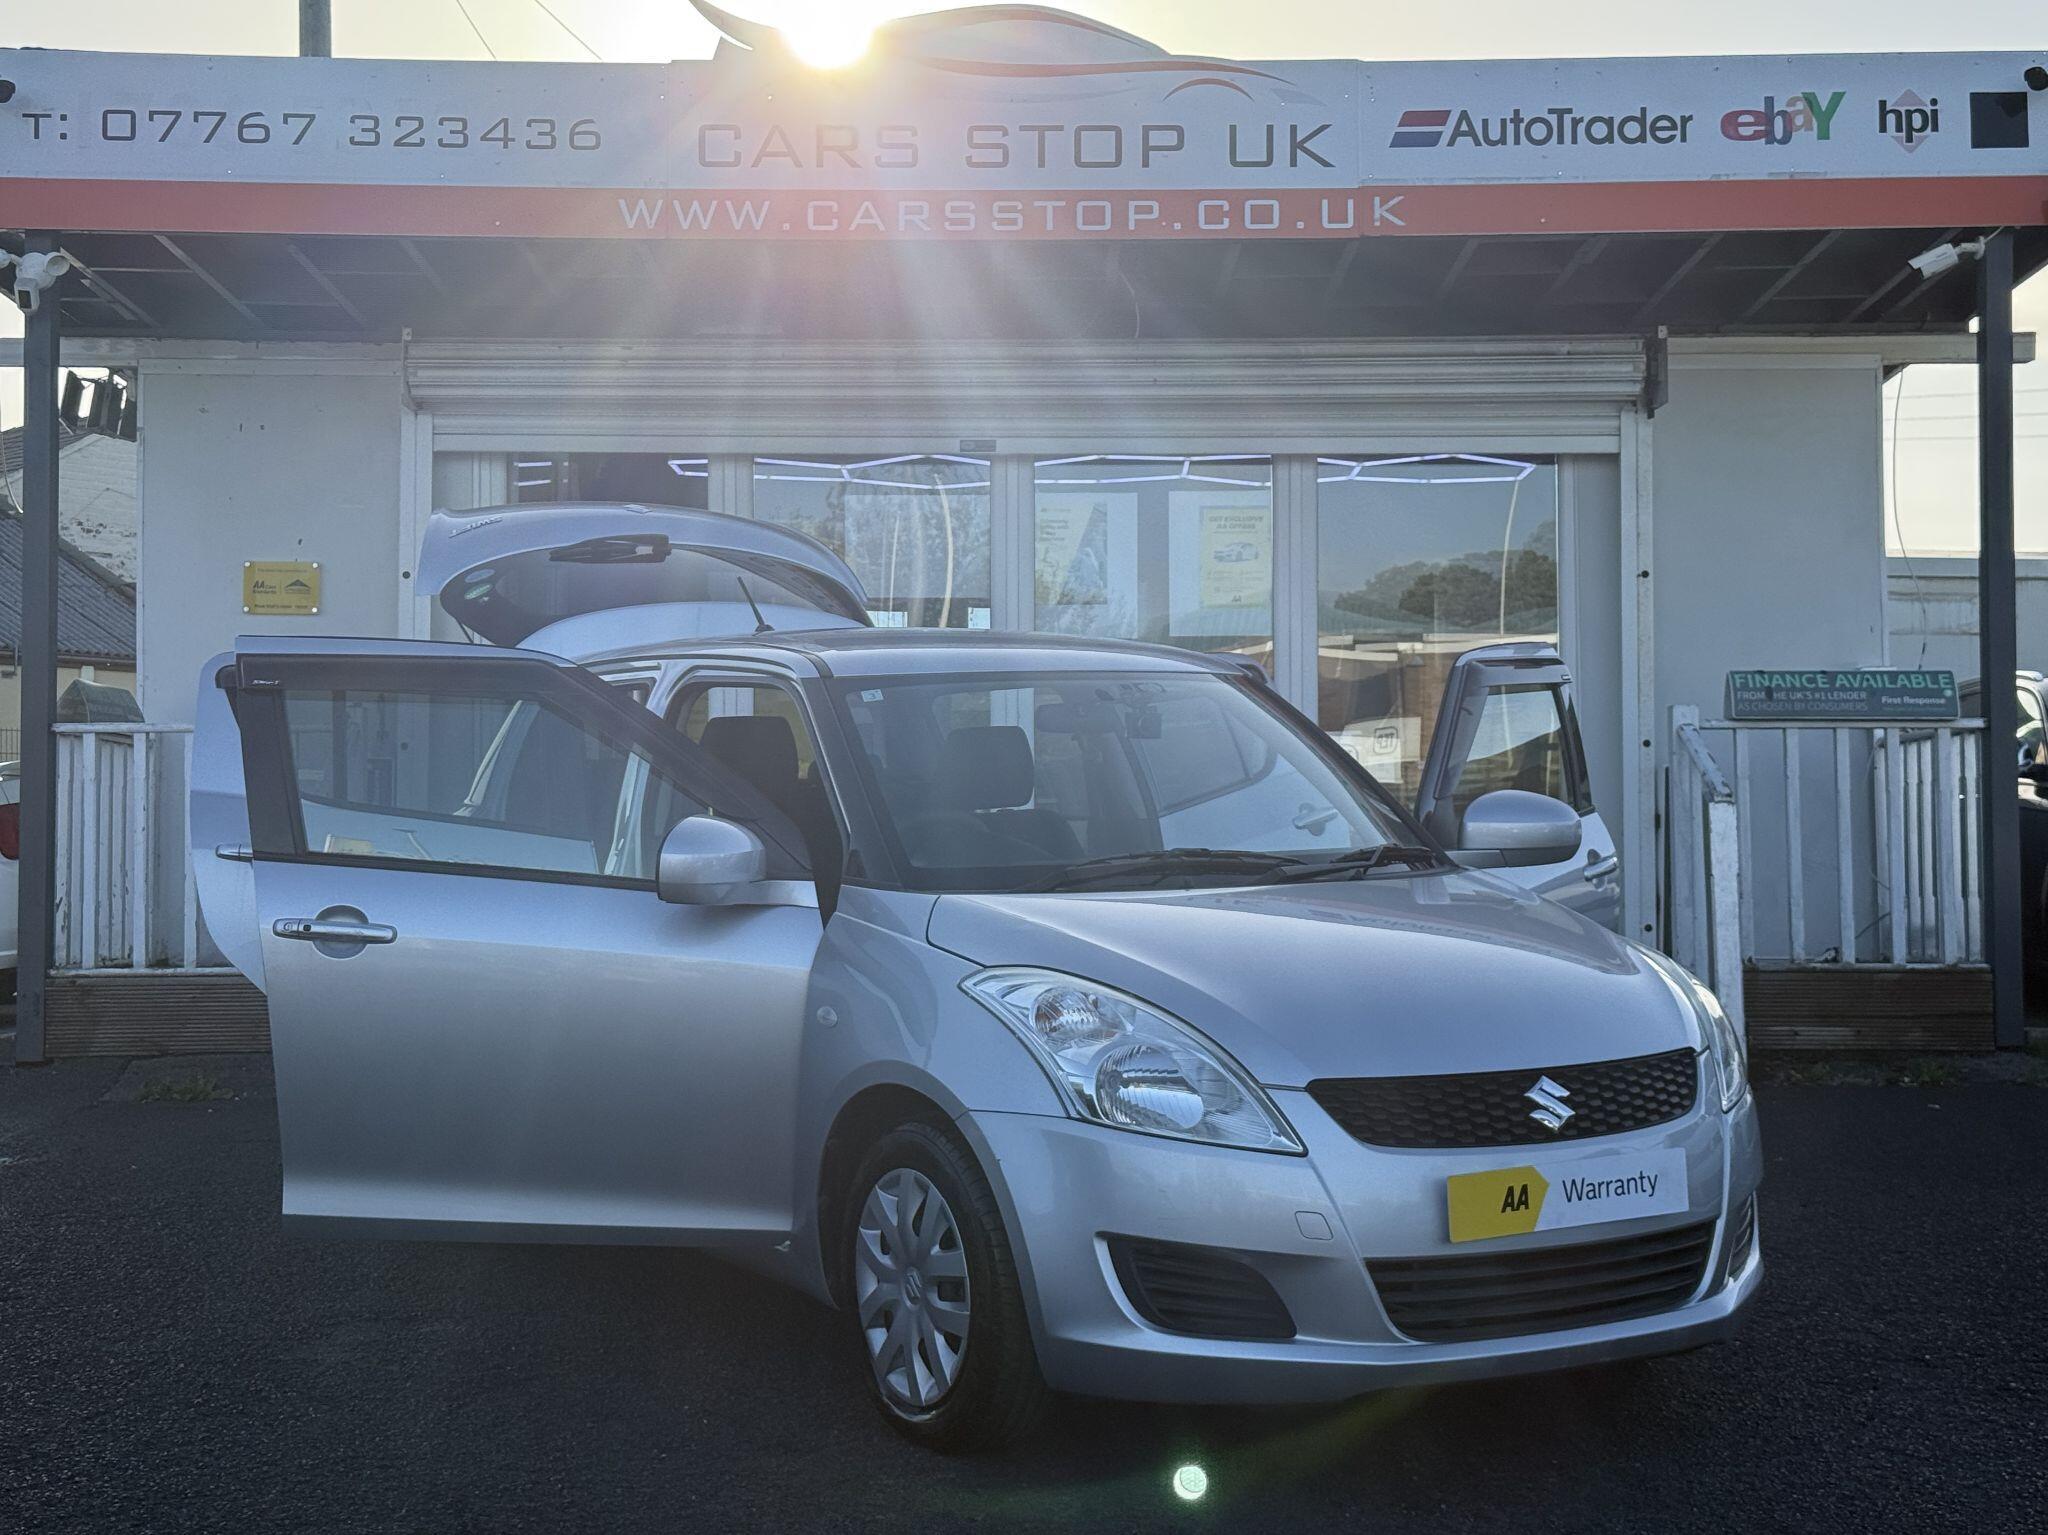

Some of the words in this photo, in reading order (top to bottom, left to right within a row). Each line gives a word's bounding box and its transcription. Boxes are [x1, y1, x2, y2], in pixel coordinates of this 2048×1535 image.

[22, 113, 67, 140] T:
[102, 109, 317, 146] 07767
[349, 114, 603, 151] 323436
[1446, 106, 1693, 147] AutoTrader
[1878, 97, 1940, 143] hpi
[697, 124, 920, 169] CARS
[965, 124, 1186, 169] STOP
[1227, 123, 1337, 168] UK
[617, 195, 1407, 232] WWW.CARSSTOP.CO.UK
[1734, 673, 1830, 688] FINANCE
[1835, 673, 1953, 688] AVAILABLE
[1737, 691, 1764, 700] FROM
[1789, 691, 1813, 700] UK'S
[1827, 691, 1867, 700] LENDER
[1881, 696, 1901, 704] First
[1903, 696, 1946, 706] Response
[1501, 1183, 1530, 1213] AA
[1562, 1170, 1658, 1203] Warranty
